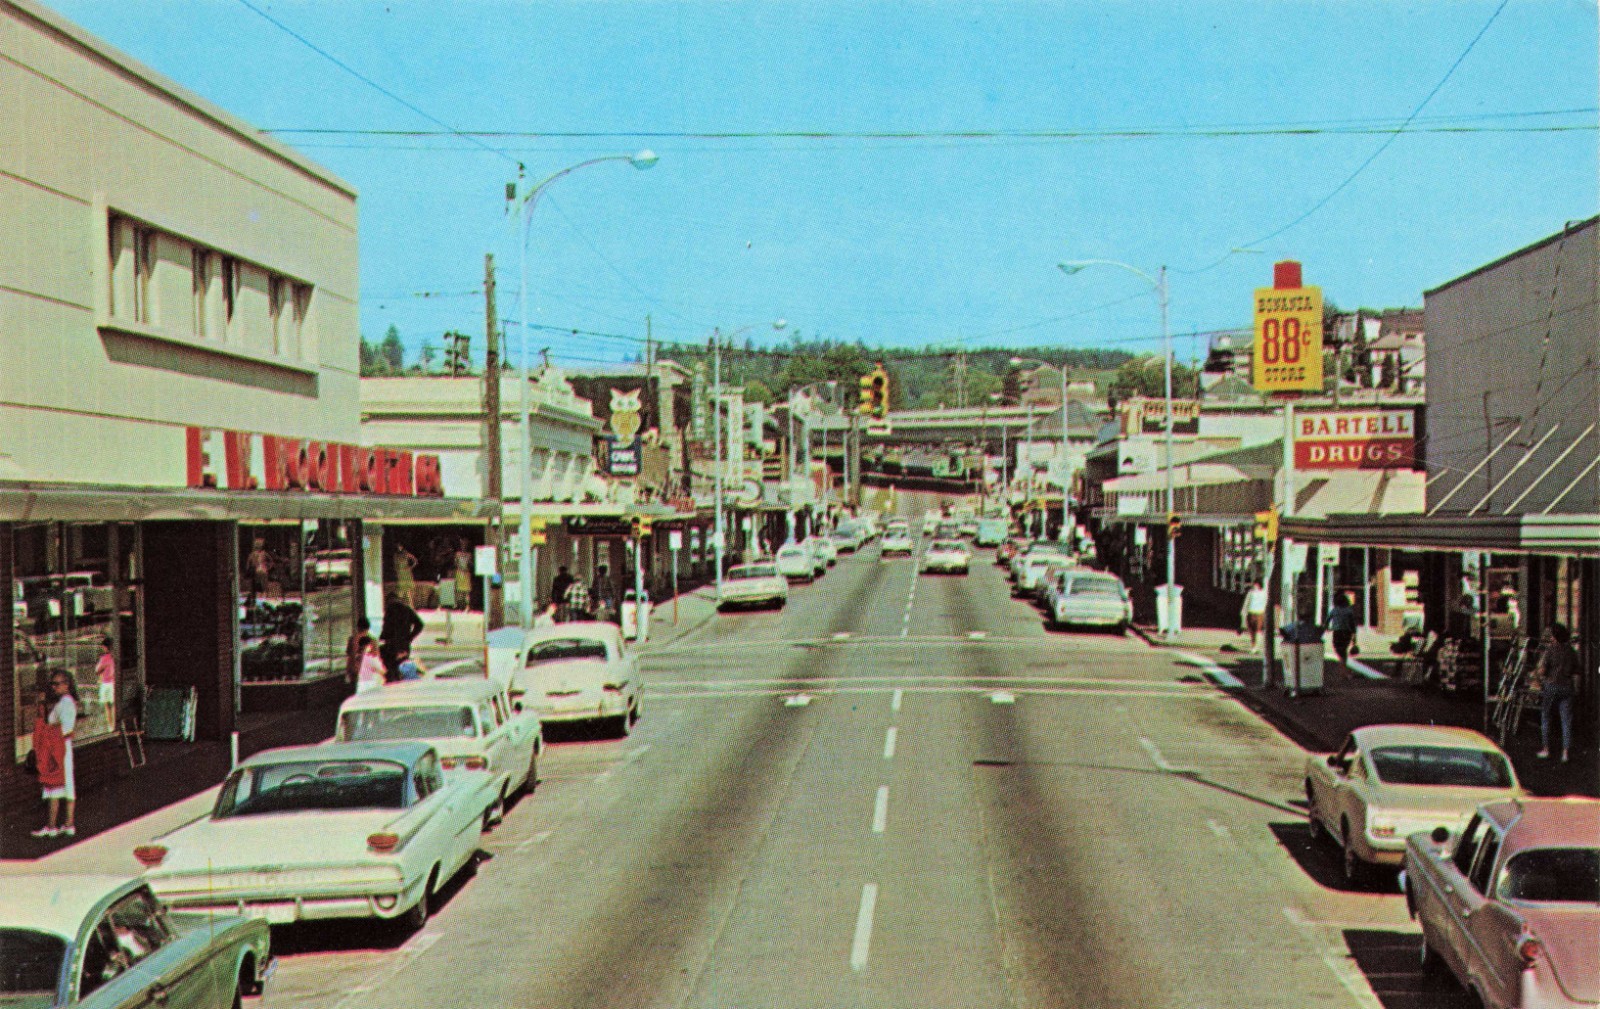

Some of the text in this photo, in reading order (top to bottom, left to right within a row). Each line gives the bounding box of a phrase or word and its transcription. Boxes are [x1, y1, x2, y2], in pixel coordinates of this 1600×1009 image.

[1265, 365, 1306, 382] STORE
[1301, 414, 1409, 436] BARTELL
[1309, 443, 1402, 462] DRUGS
